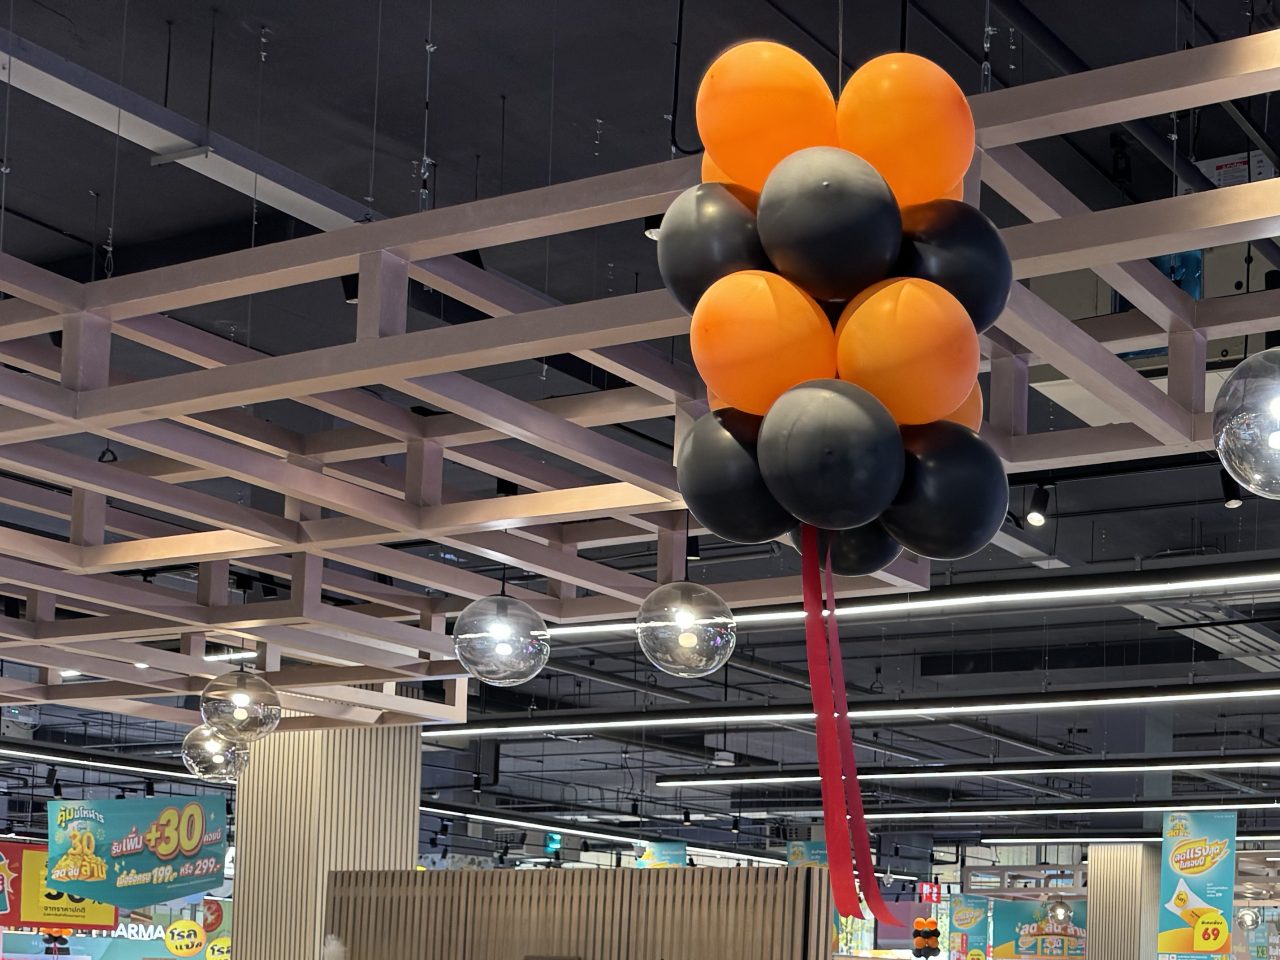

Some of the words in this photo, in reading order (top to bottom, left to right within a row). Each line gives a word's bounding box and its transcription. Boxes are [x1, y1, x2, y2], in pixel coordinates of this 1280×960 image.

[146, 803, 204, 858] +30
[69, 830, 95, 856] 30
[92, 923, 165, 940] ARMA
[1202, 927, 1220, 941] 69
